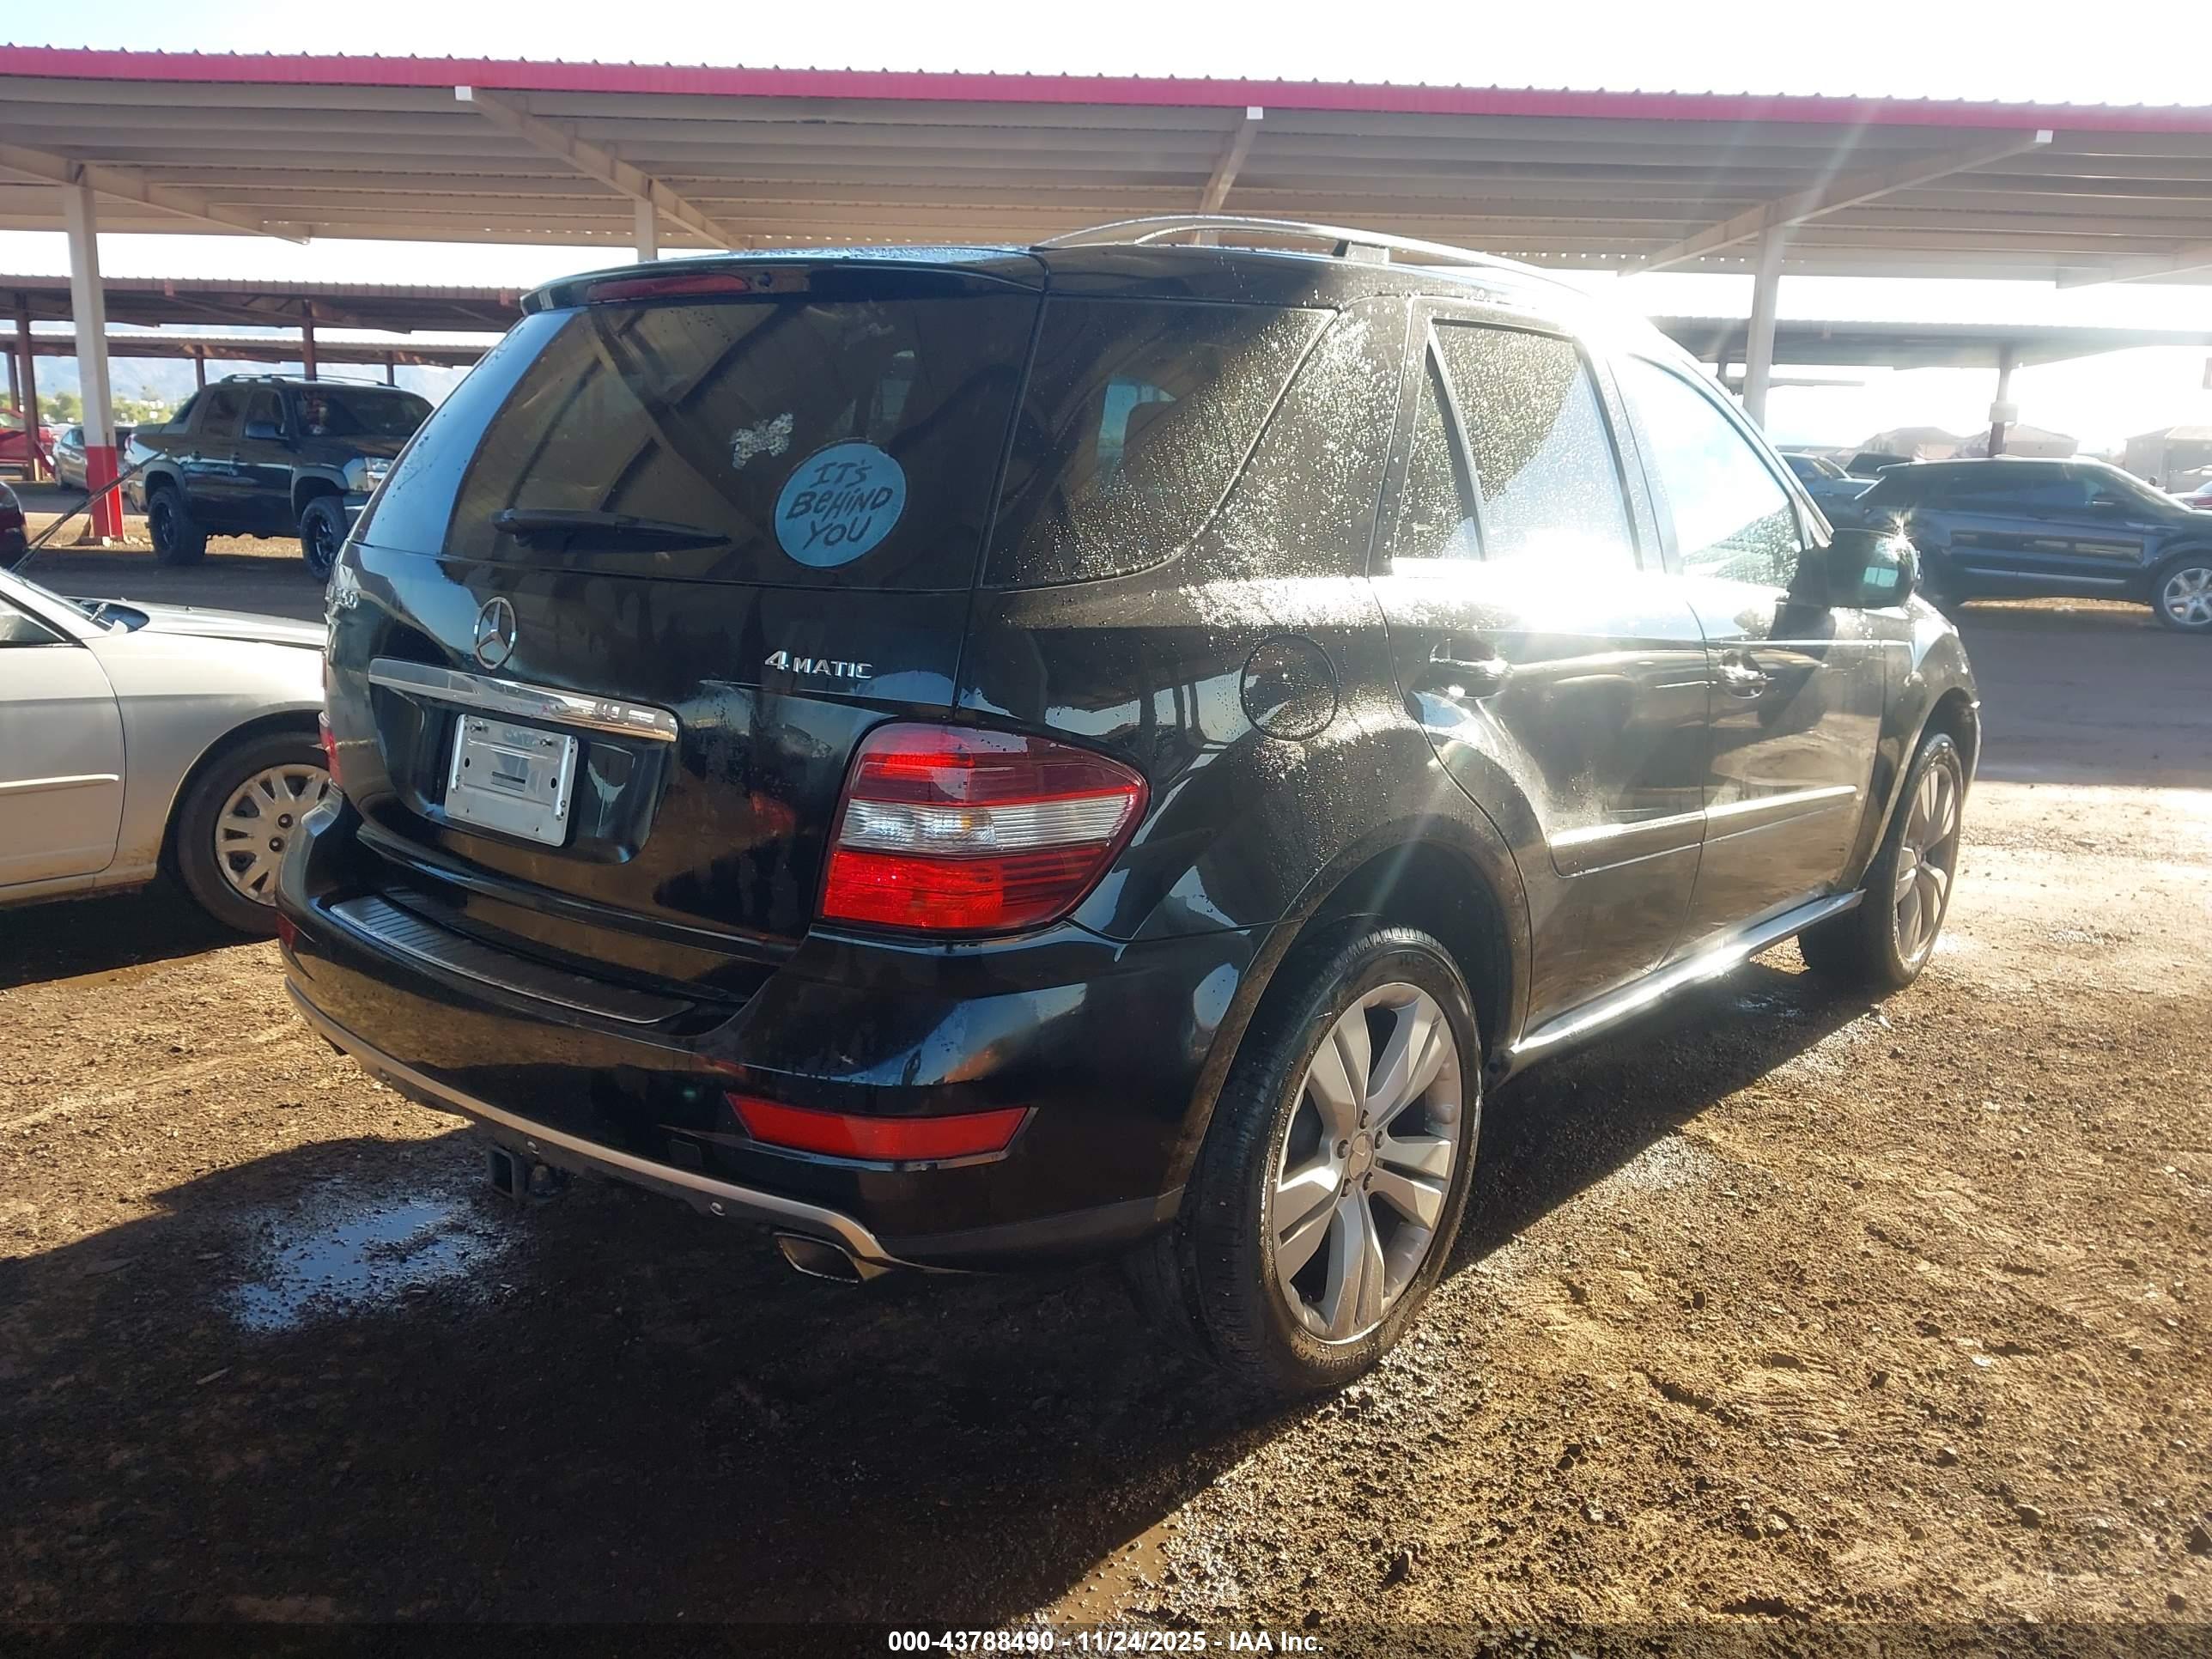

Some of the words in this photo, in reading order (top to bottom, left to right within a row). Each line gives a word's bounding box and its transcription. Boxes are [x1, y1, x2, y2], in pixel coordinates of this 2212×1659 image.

[809, 459, 873, 489] IT'S
[803, 515, 872, 550] YOU
[764, 650, 873, 679] 4MATIC
